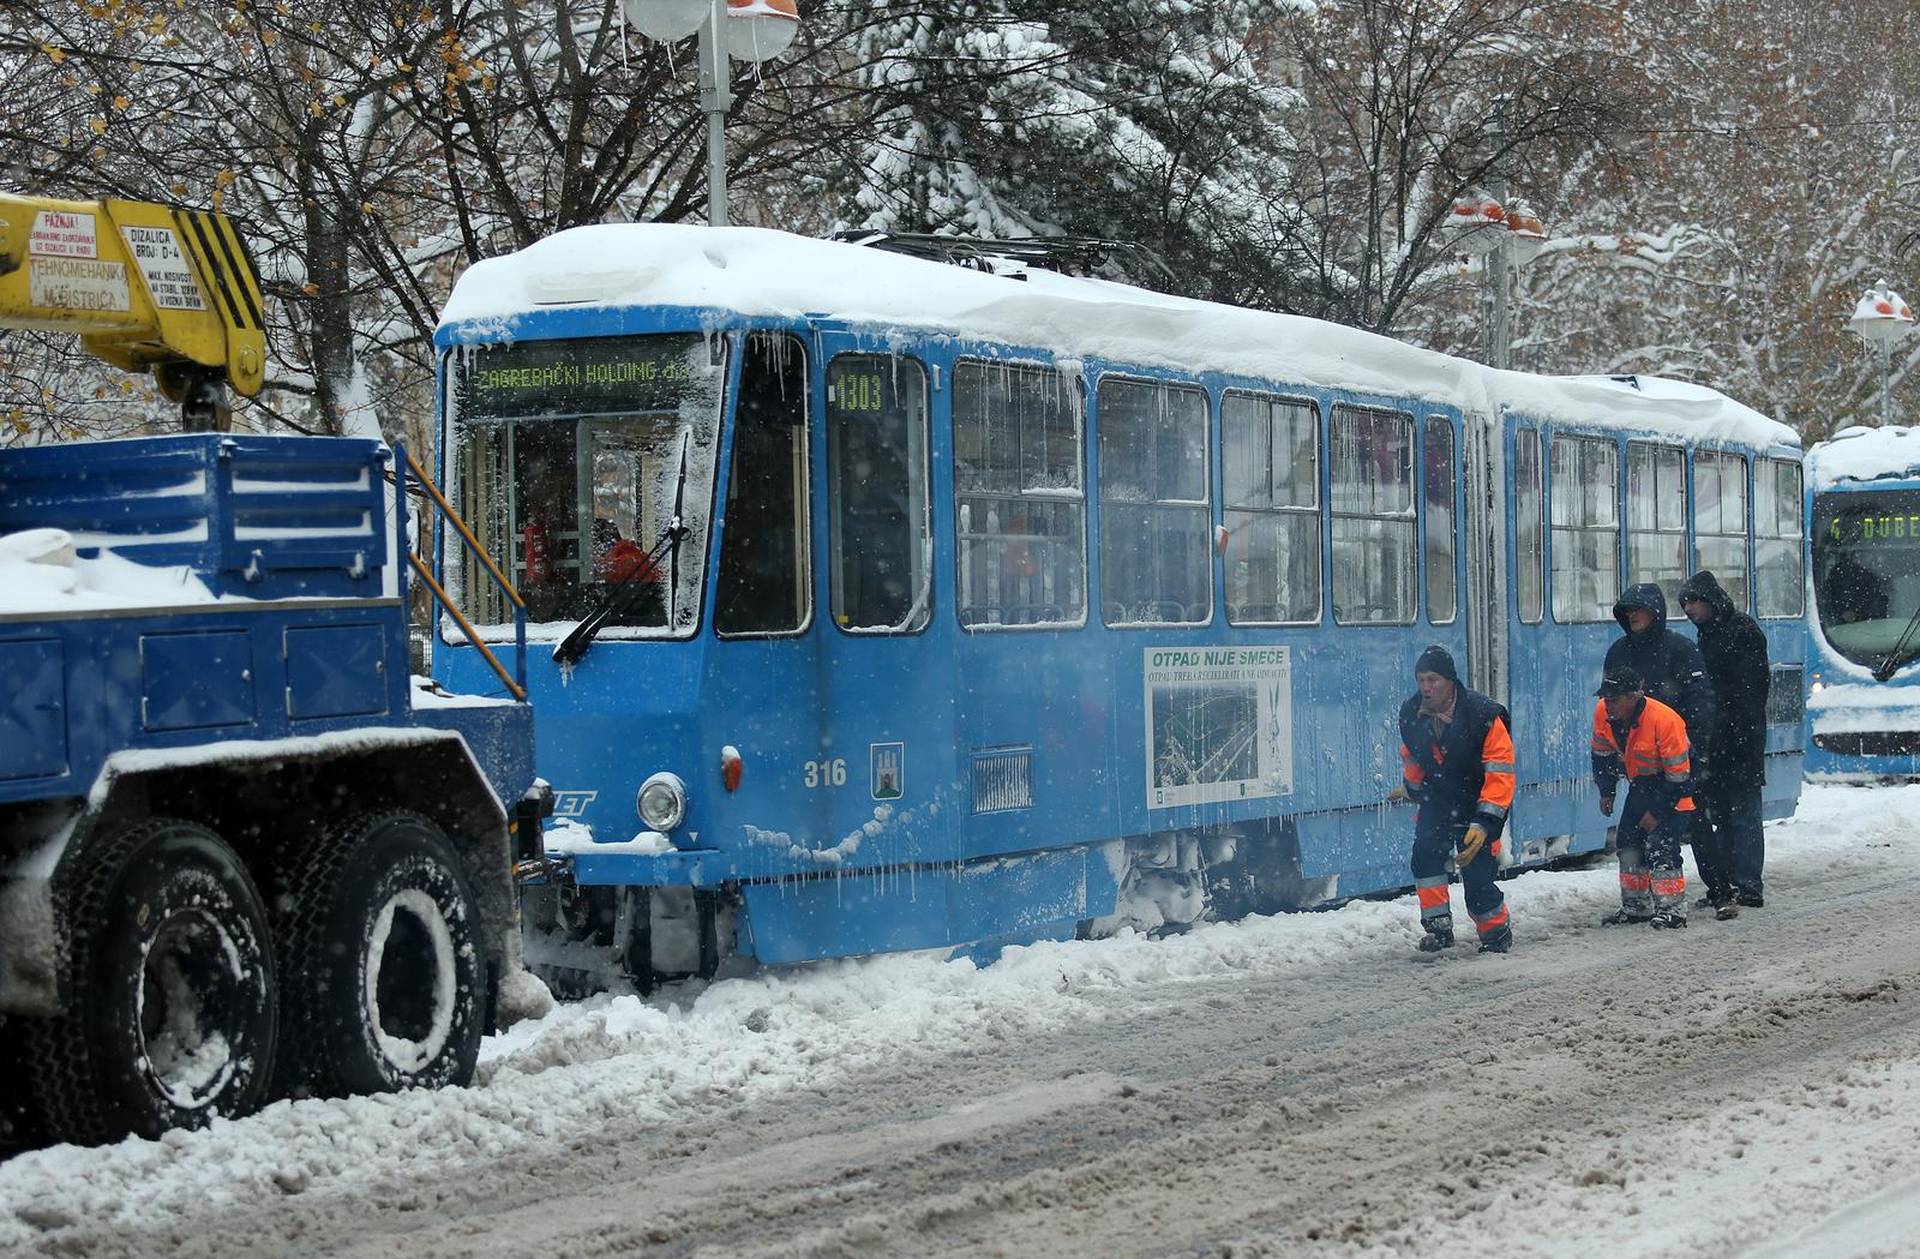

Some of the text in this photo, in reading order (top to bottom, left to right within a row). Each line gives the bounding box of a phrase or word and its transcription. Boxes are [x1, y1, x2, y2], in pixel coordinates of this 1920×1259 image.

[44, 212, 79, 229] PAŽNJA!
[130, 229, 172, 245] DIZALICA
[136, 244, 180, 260] BROJ: D-4
[585, 361, 657, 384] HOLDING
[837, 373, 882, 411] 1303
[1863, 516, 1920, 539] DUBE
[1152, 652, 1200, 667] OTPAD
[1204, 651, 1236, 666] NIJE
[804, 757, 847, 789] 316
[552, 789, 599, 817] ET
